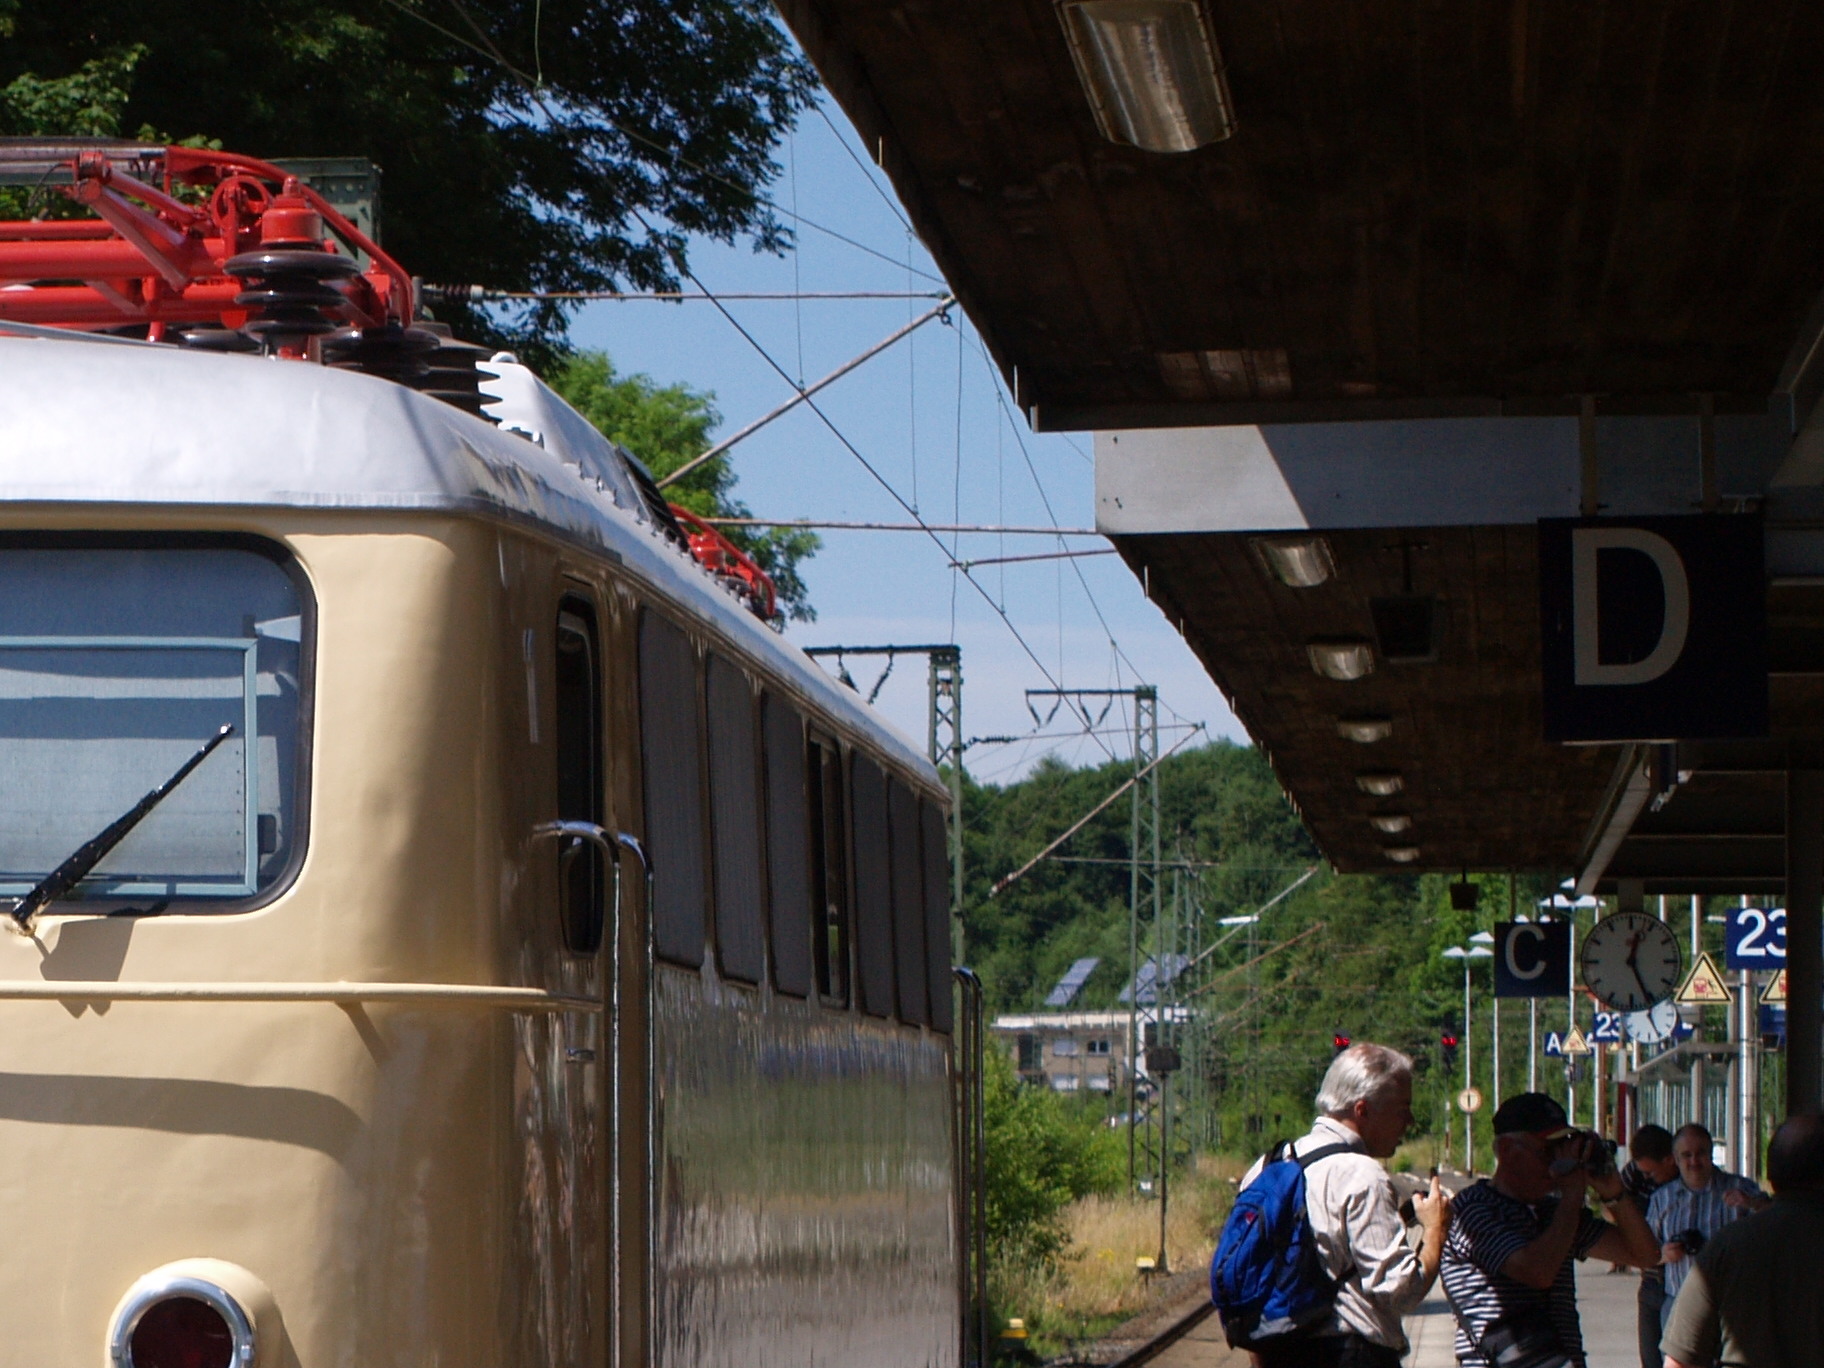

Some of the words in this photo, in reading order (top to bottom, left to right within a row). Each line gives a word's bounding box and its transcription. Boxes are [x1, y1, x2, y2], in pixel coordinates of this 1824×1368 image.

[1572, 528, 1689, 685] D
[1505, 924, 1547, 980] C
[1546, 1032, 1562, 1053] A
